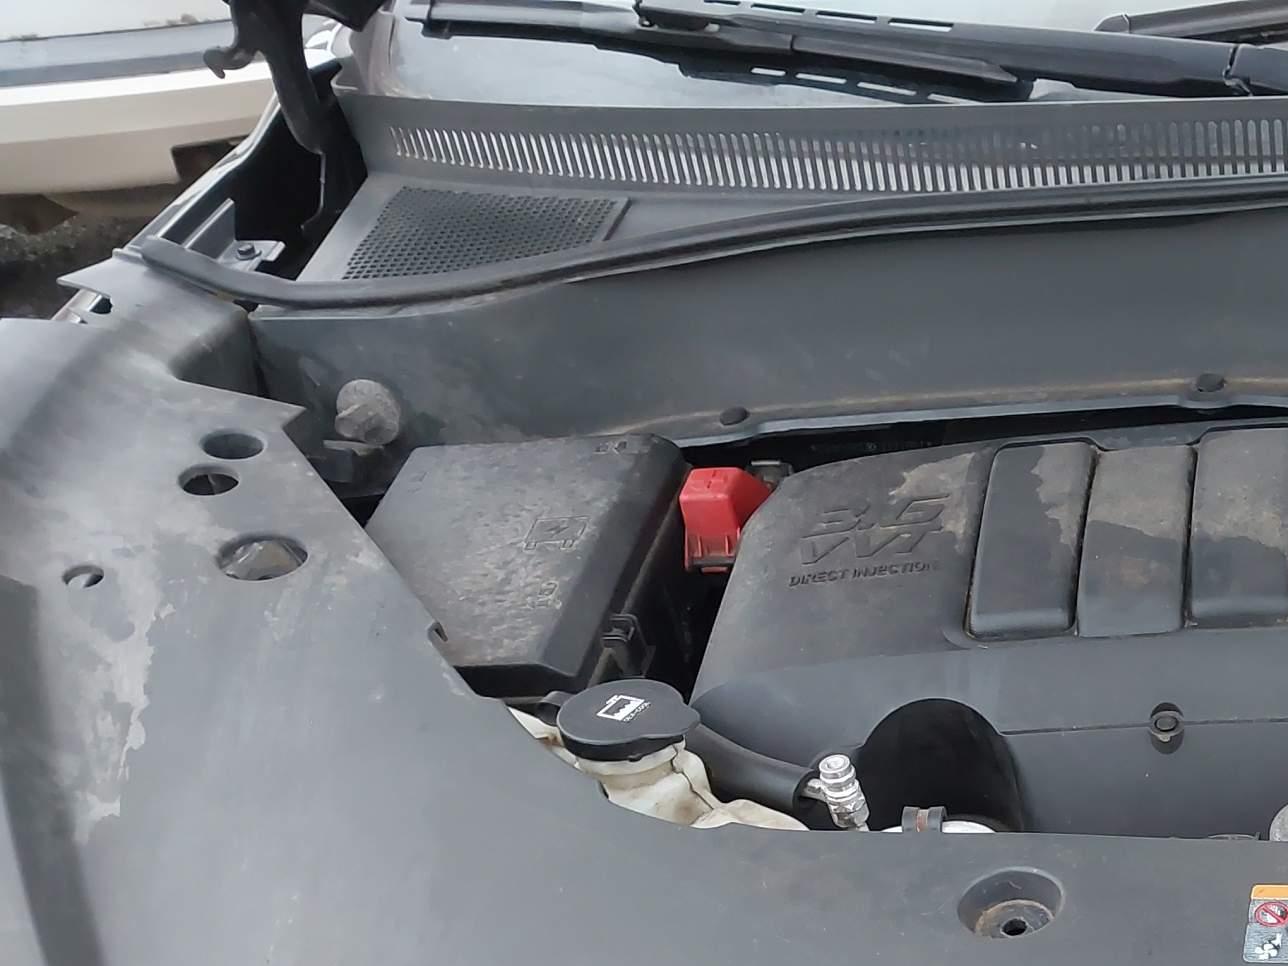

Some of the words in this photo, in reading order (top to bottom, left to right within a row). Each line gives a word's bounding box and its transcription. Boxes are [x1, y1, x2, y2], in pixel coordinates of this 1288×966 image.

[800, 495, 950, 538] 3.6
[801, 527, 944, 565] VVT
[788, 570, 850, 587] DIRECT
